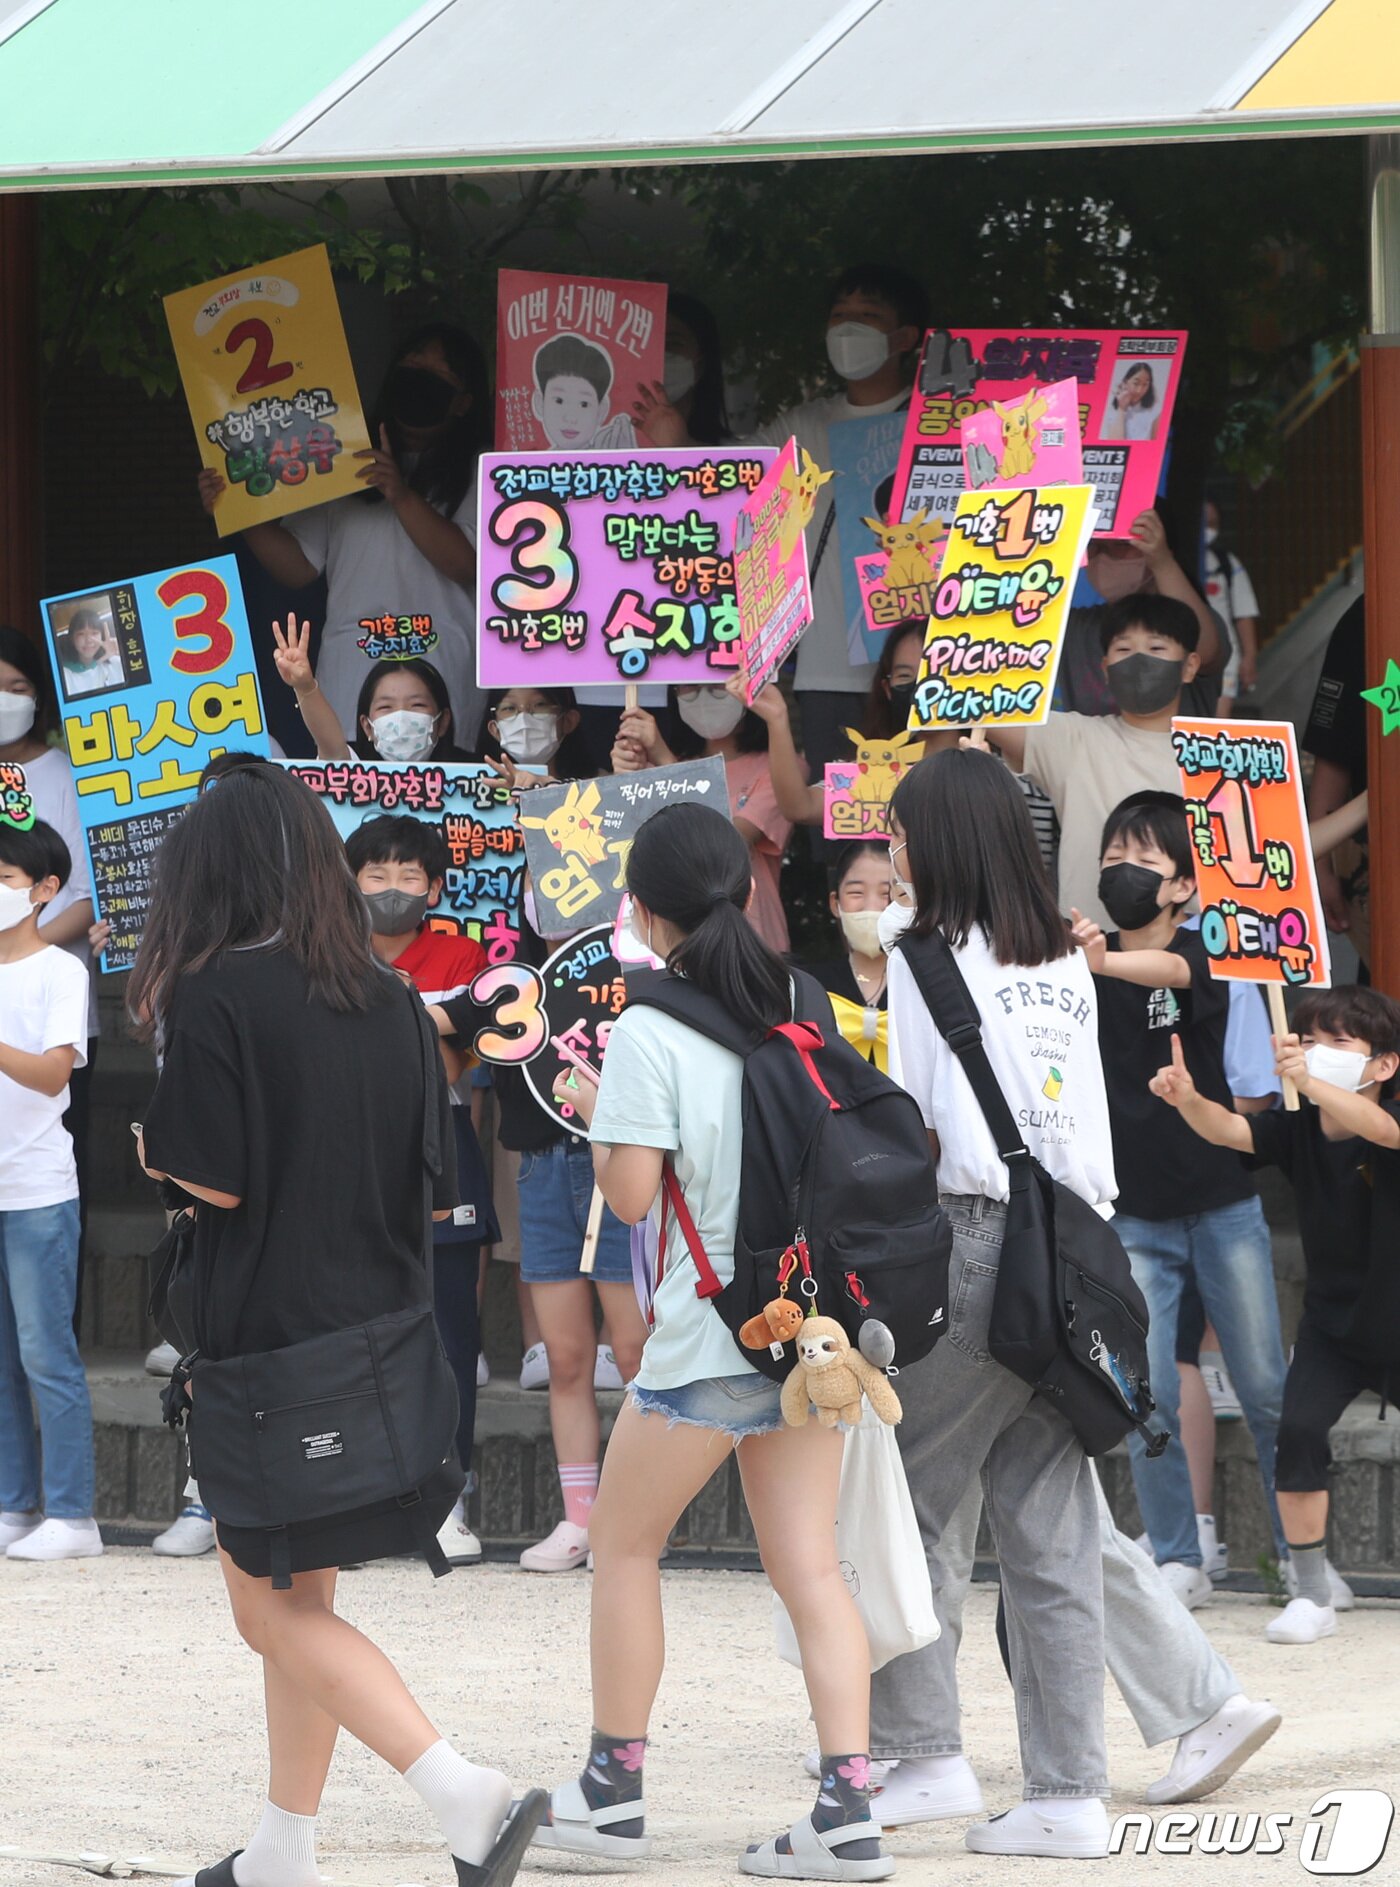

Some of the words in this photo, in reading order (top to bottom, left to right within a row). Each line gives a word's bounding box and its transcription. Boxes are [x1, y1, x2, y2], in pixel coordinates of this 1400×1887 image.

[507, 287, 548, 340] 이번
[553, 284, 616, 340] 선거엔
[616, 299, 654, 359] 2번
[225, 318, 294, 394] 2
[224, 396, 293, 443] 행복한
[295, 389, 336, 420] 학교
[681, 460, 763, 496] 기호3번
[1083, 471, 1122, 484] 자치회
[606, 513, 716, 560] 말보다는
[956, 491, 1061, 557] 기호1번
[494, 500, 575, 612] 3
[157, 569, 234, 675] 3
[360, 612, 430, 637] 기호3번
[869, 582, 937, 624] 엄지
[365, 632, 426, 658] 송지효
[489, 613, 585, 649] 기호3번
[1381, 686, 1400, 714] 2
[0, 766, 23, 793] 번
[292, 765, 442, 808] 교부회장후보
[619, 783, 652, 806] 찍어
[1206, 778, 1266, 886] 1
[1264, 845, 1291, 889] 번
[556, 934, 614, 980] 전교
[473, 965, 545, 1061] 3
[994, 981, 1091, 1027] FRESH
[1026, 1025, 1072, 1047] LEMONS
